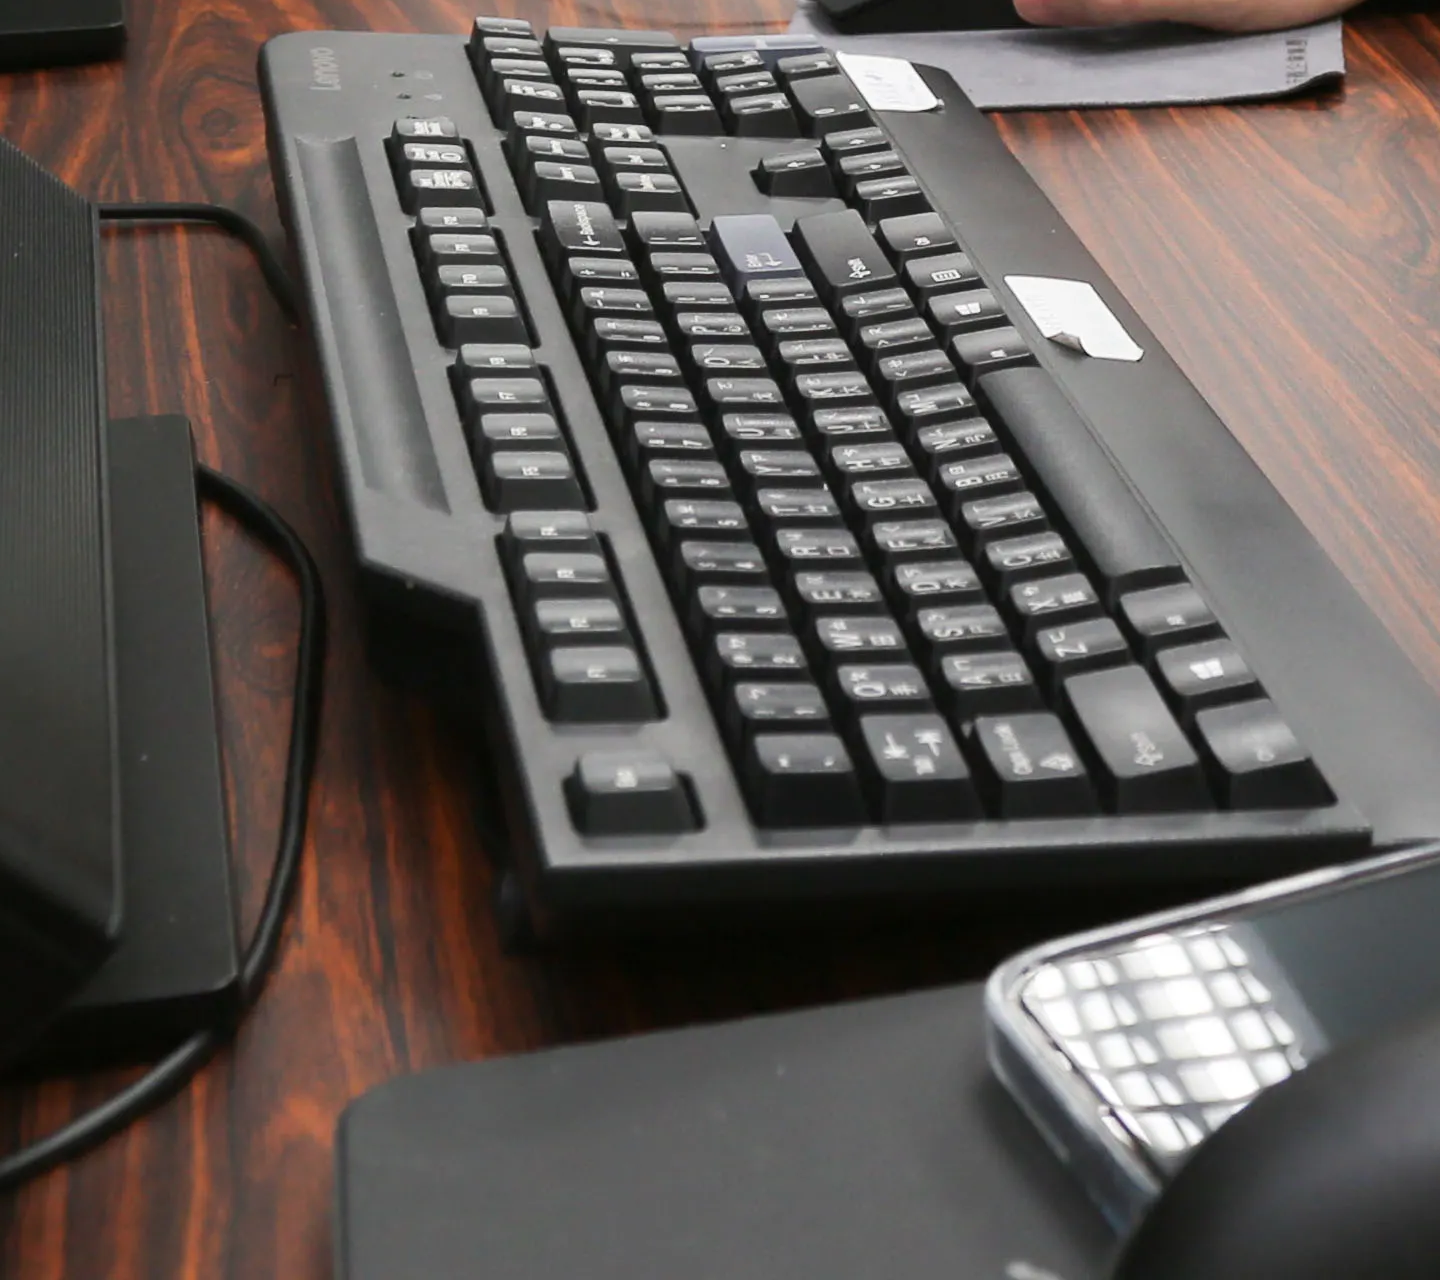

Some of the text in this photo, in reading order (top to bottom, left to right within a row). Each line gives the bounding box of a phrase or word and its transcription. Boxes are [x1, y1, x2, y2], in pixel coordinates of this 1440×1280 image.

[309, 47, 342, 91] Lenovo
[573, 204, 593, 235] Backspace
[705, 357, 730, 366] O
[809, 388, 832, 396] K
[913, 402, 939, 414] M
[736, 428, 763, 437] U
[933, 439, 957, 450] N
[757, 465, 778, 473] Y
[846, 460, 873, 469] H
[957, 477, 982, 487] B
[869, 497, 895, 507] G
[772, 505, 794, 514] T
[979, 515, 1005, 526] V
[792, 547, 818, 555] R
[914, 582, 940, 591] D
[814, 589, 838, 600] E
[1028, 598, 1058, 611] X
[934, 628, 963, 637] S
[834, 631, 862, 648] W
[1056, 642, 1088, 658] Z
[960, 676, 990, 686] A
[855, 684, 886, 697] Q
